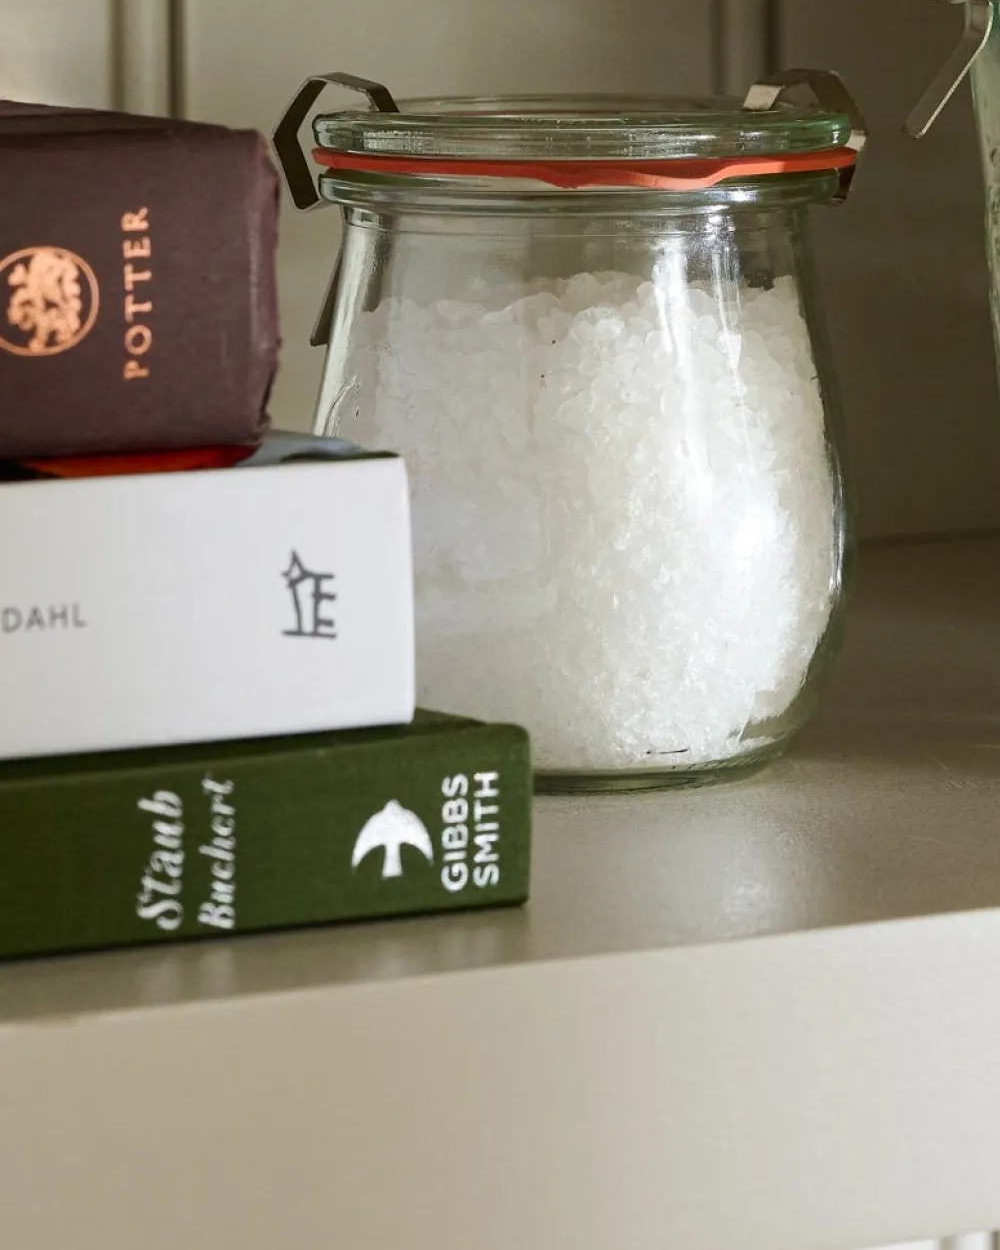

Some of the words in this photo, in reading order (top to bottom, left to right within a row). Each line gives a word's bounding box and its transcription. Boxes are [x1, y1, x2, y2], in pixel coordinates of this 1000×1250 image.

[121, 206, 152, 380] POTTER
[0, 603, 87, 634] DAHL
[136, 790, 184, 931] Staub
[441, 773, 469, 892] GIBBS
[473, 770, 500, 888] SMITH
